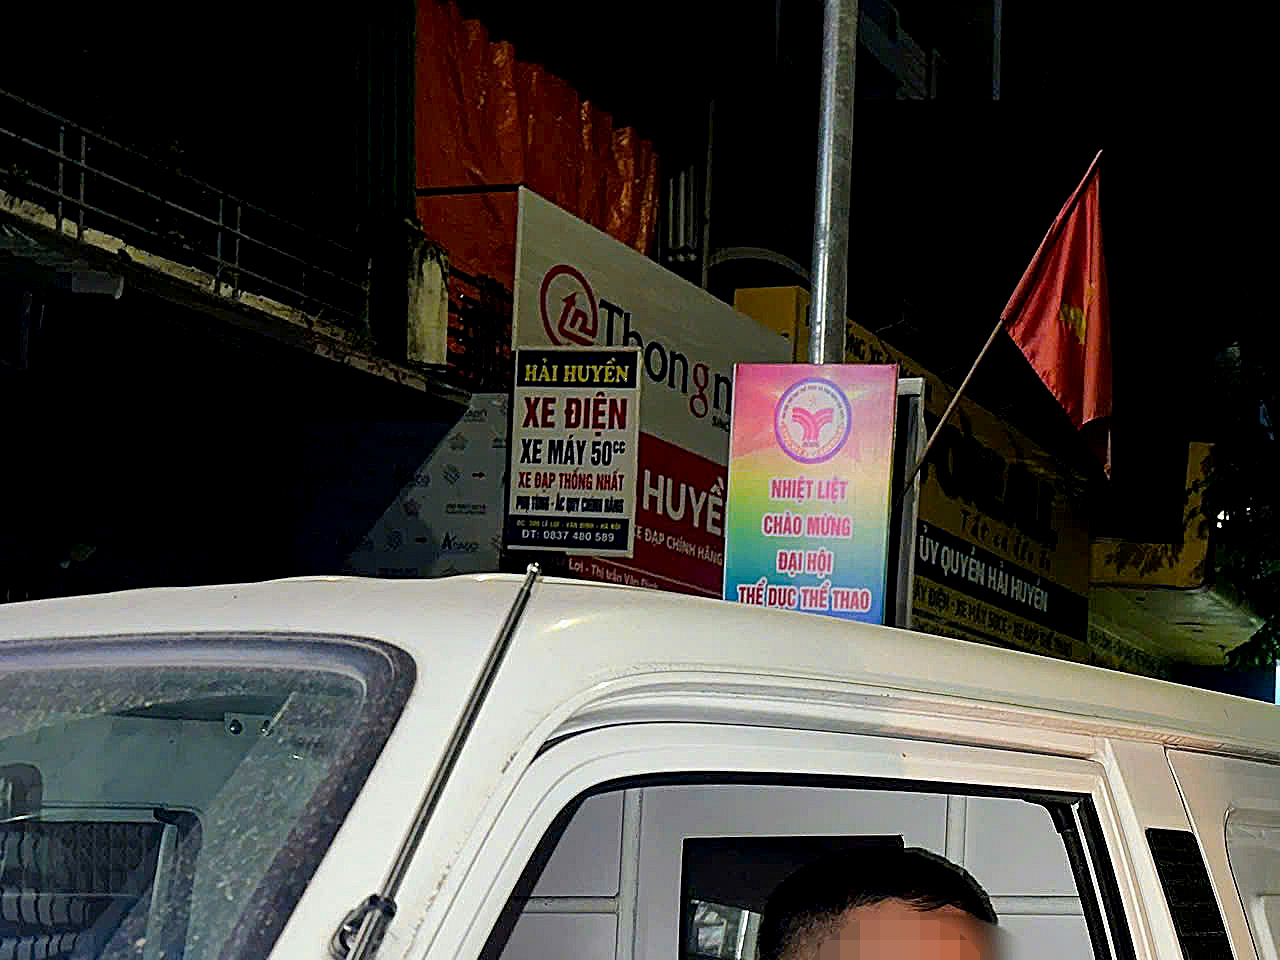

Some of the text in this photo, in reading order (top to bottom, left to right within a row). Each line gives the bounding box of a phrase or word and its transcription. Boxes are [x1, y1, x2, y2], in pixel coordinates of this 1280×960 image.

[524, 357, 630, 383] HẢI HUYỀN
[522, 391, 628, 437] XE ĐIỆN
[520, 438, 543, 465] XE
[547, 434, 587, 465] MÁY
[517, 466, 625, 493] XE ĐẠP THỐNG NHẤT
[770, 475, 849, 504] NHIỆT LIỆT
[763, 512, 852, 537] CHÀO MỪNG
[777, 549, 833, 578] ĐẠI HỘI
[738, 578, 870, 610] THỂ DỤC THỂ THAO
